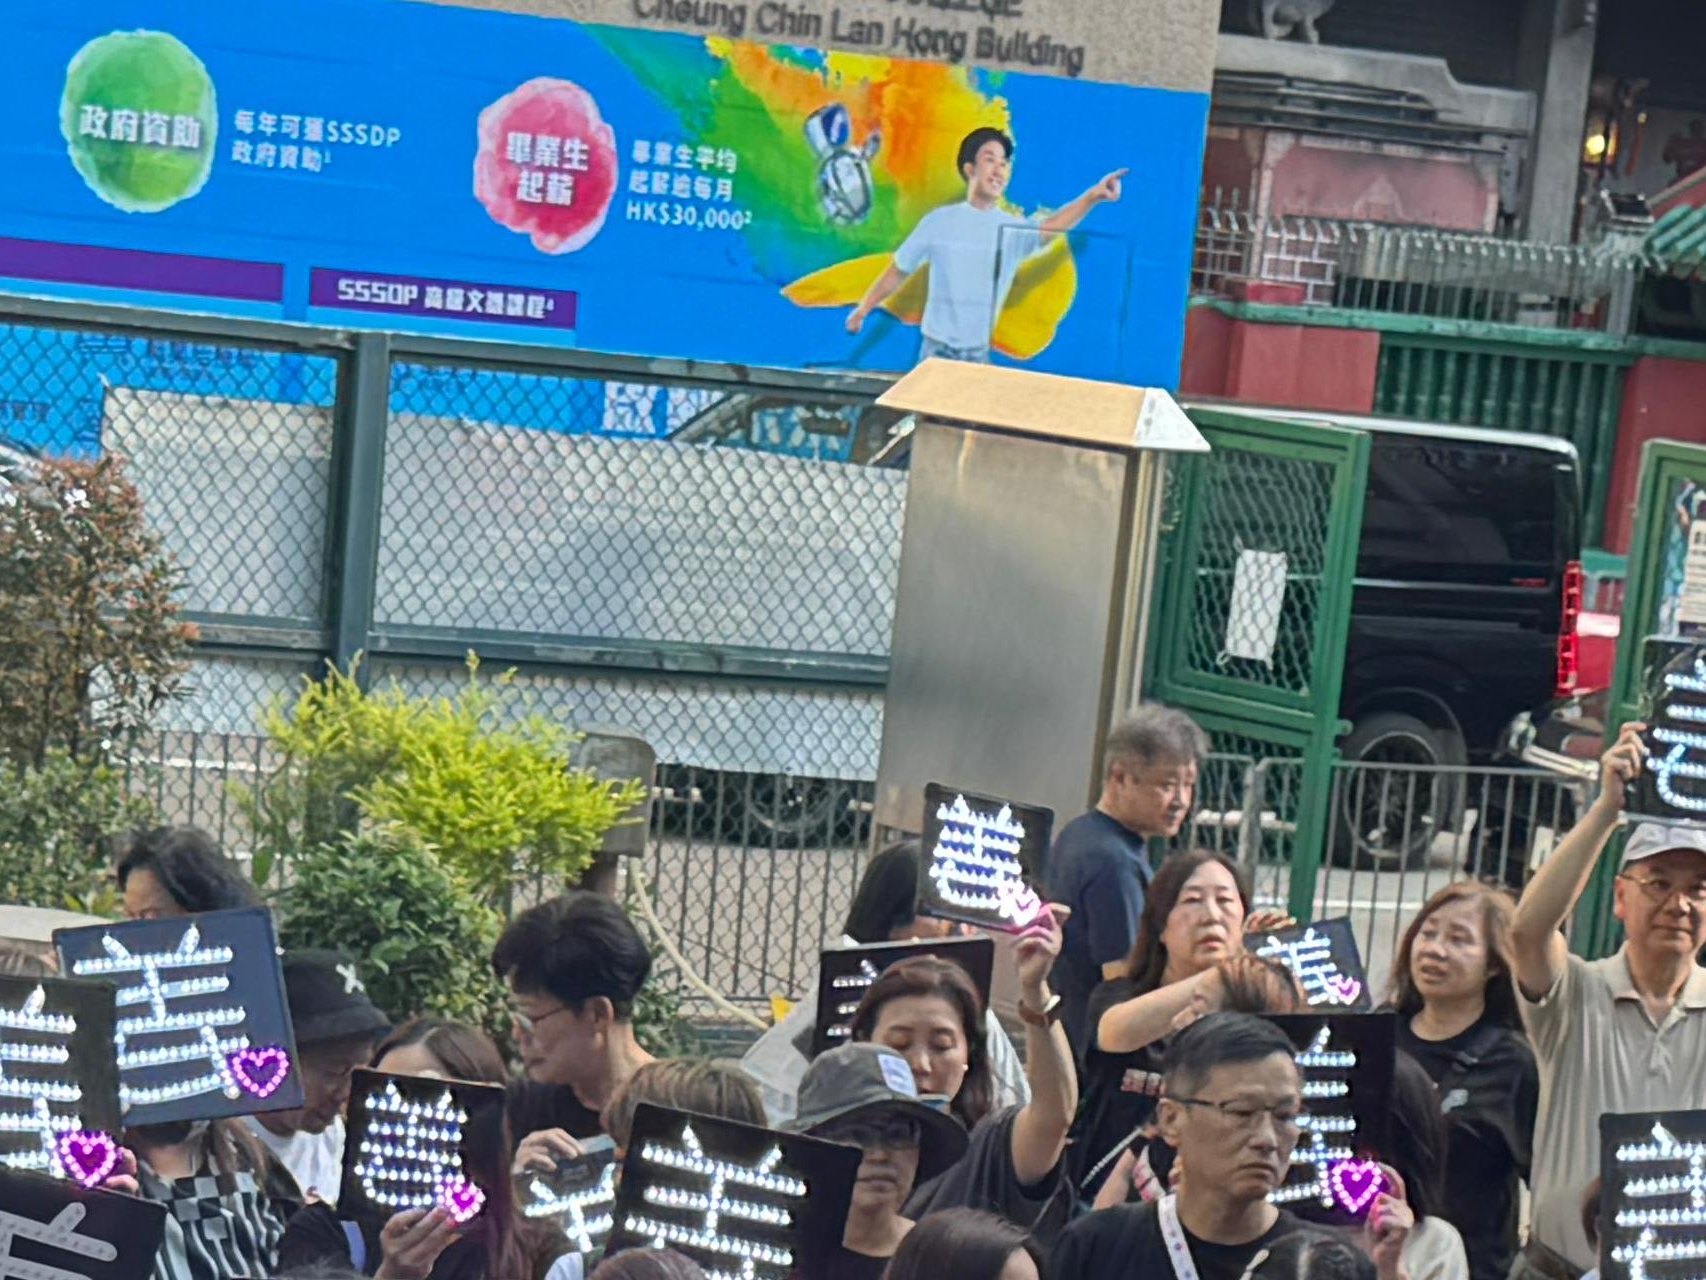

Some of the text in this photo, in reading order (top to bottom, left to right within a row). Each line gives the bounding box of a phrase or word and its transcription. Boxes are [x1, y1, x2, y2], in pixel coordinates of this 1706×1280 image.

[755, 3, 822, 41] Chin
[831, 20, 884, 46] Lan
[893, 19, 968, 63] Hong
[975, 27, 1086, 77] Building
[79, 104, 202, 148] 政府資助
[506, 132, 589, 171] 畢業生
[632, 140, 738, 174] 畢業生平均
[516, 171, 575, 206] 起薪
[338, 278, 419, 306] SSSDP
